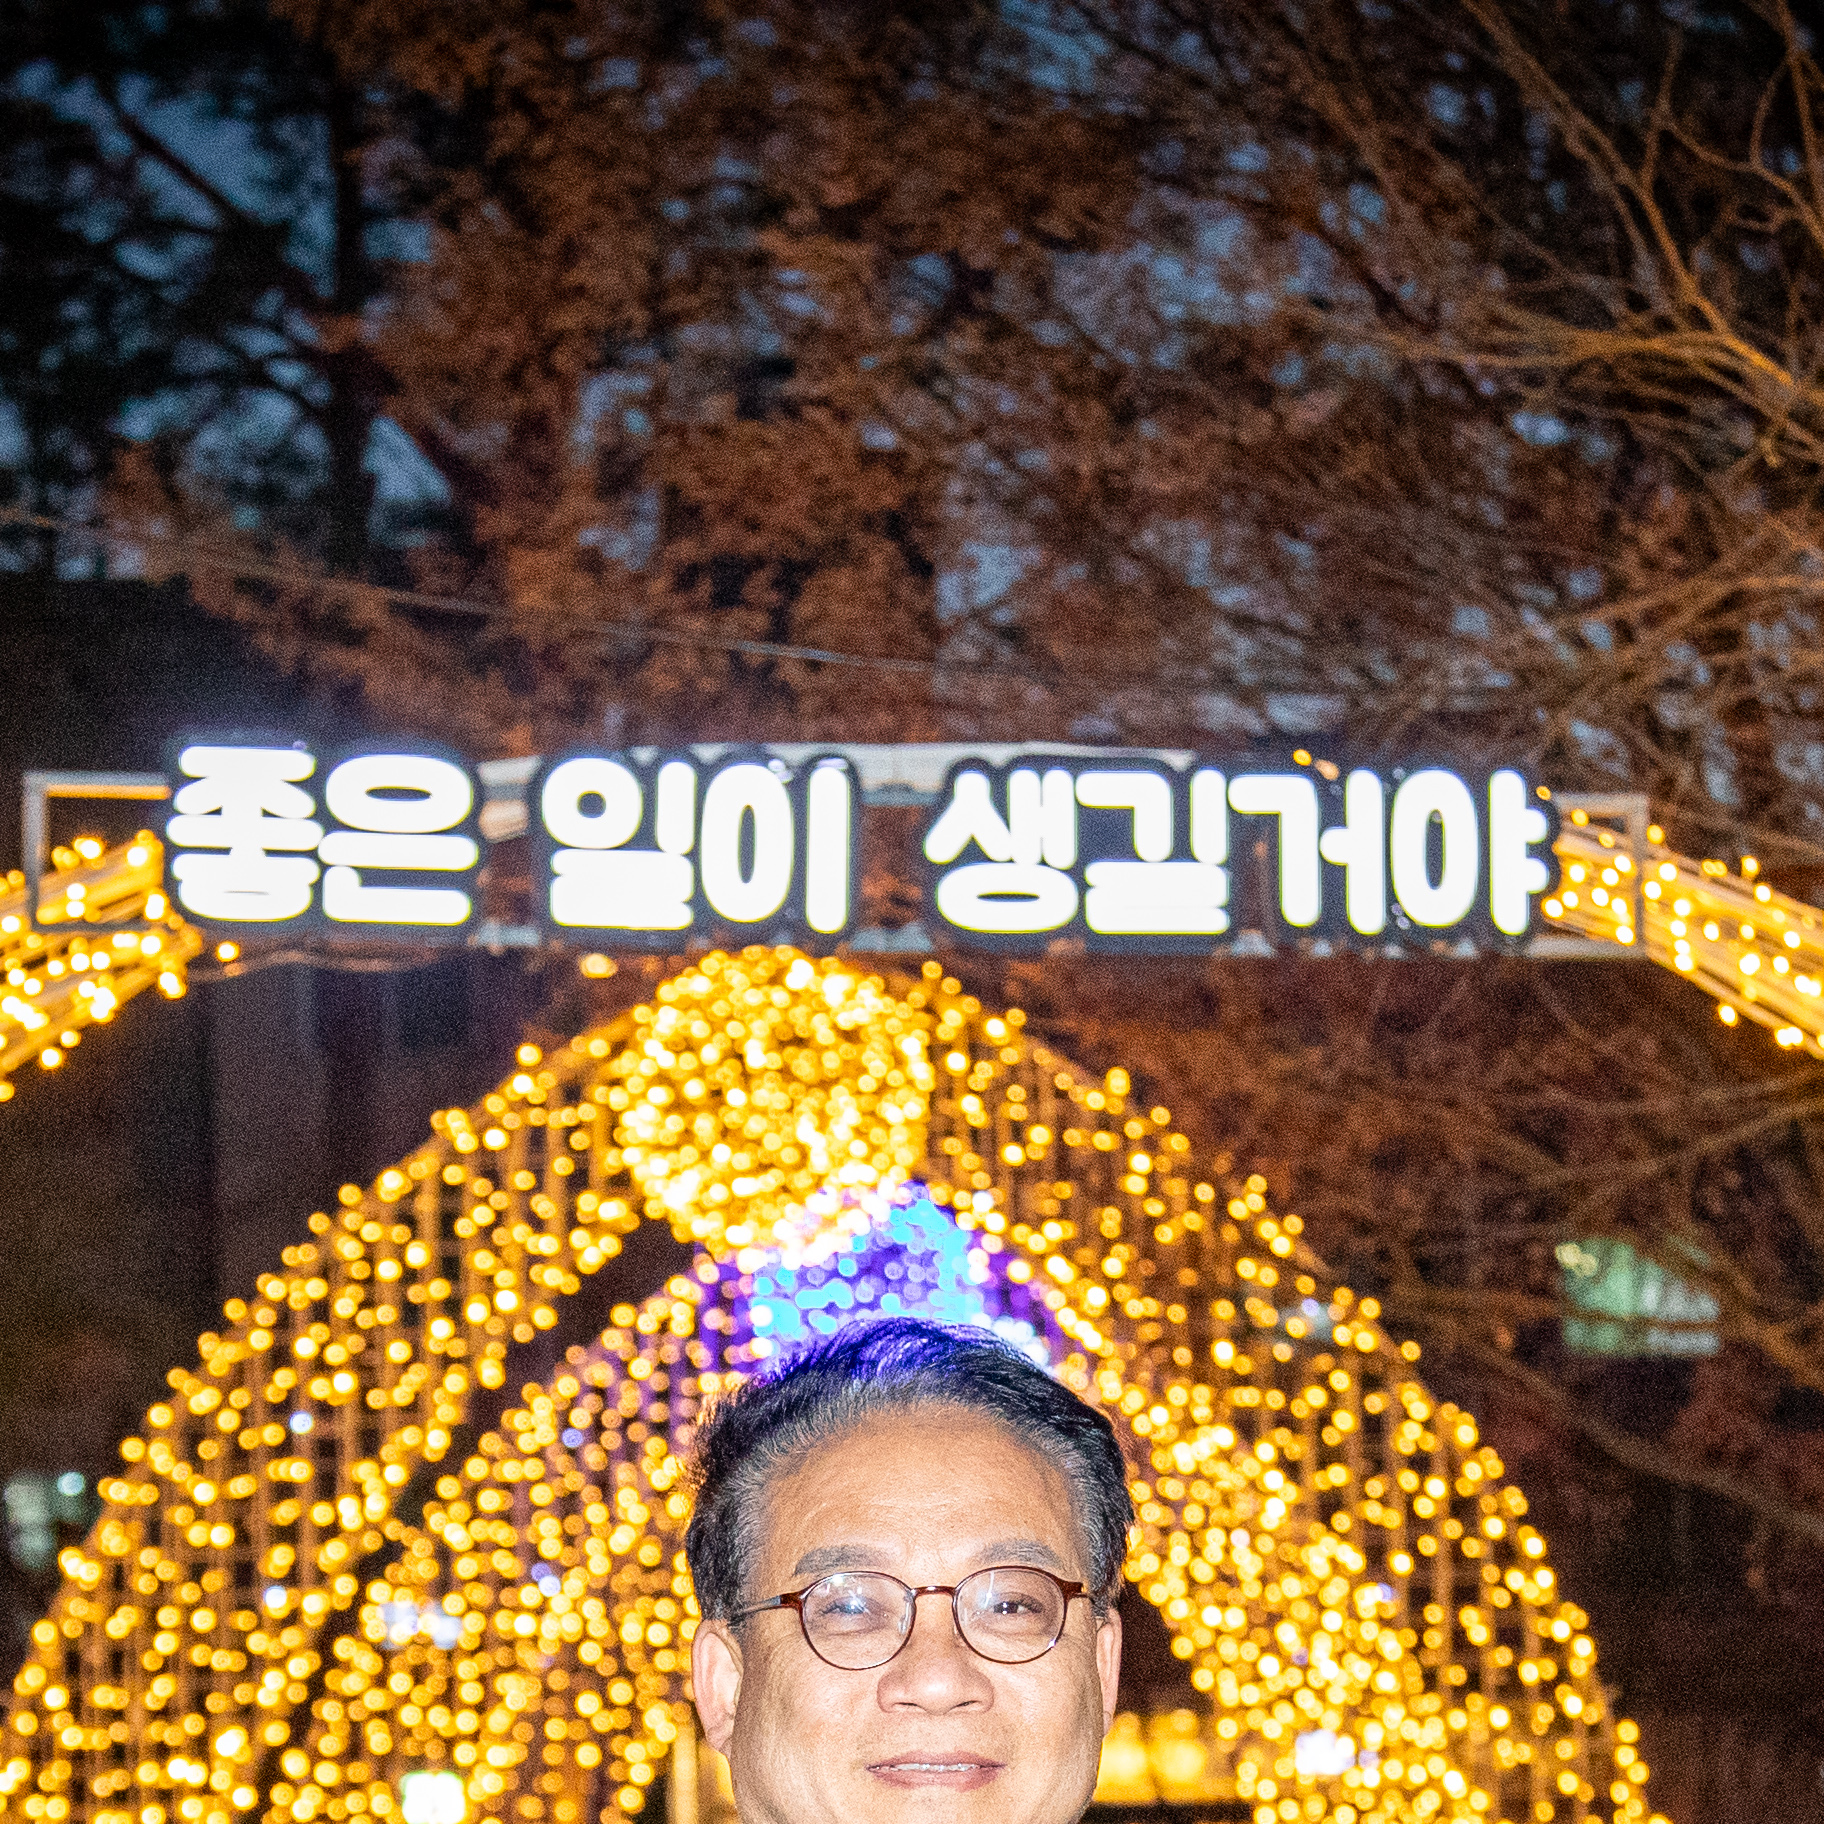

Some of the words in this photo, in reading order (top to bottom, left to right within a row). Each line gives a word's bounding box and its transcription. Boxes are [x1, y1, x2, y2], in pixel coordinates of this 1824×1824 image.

[166, 745, 479, 925] 좋은
[542, 756, 850, 934] 일이
[924, 768, 1550, 936] 생길거야
